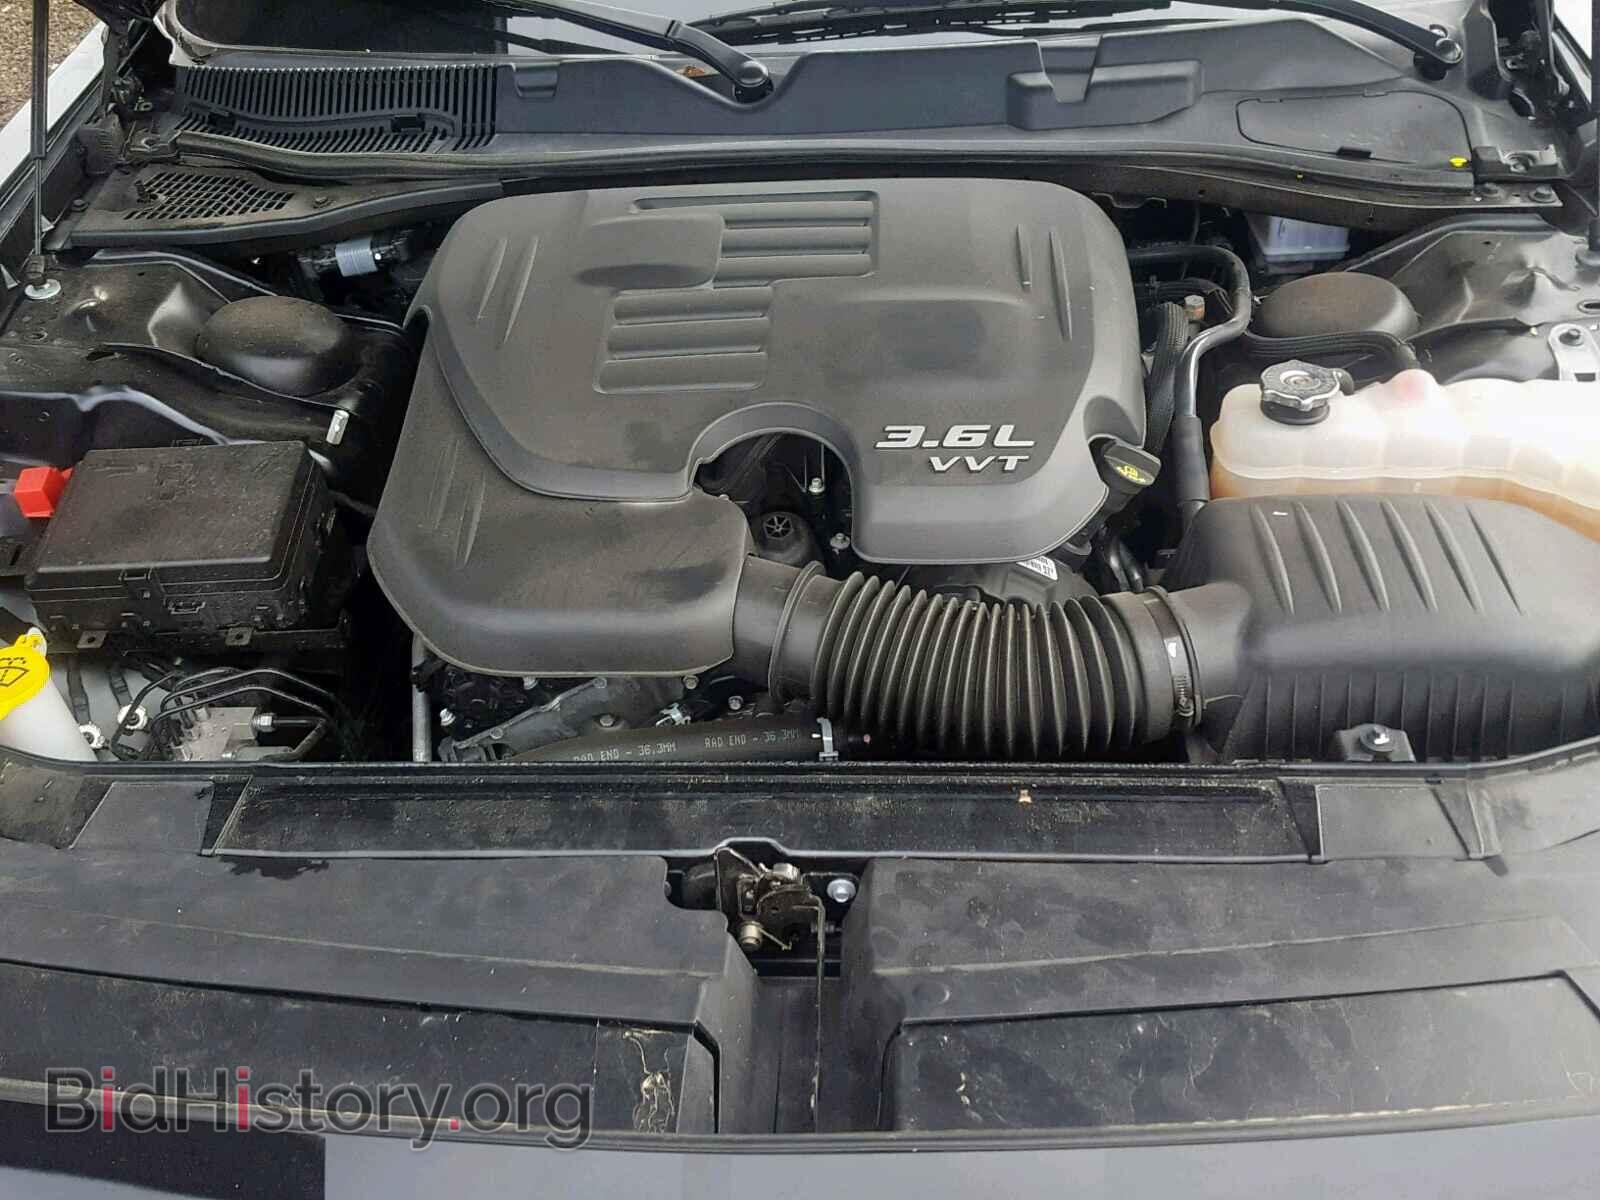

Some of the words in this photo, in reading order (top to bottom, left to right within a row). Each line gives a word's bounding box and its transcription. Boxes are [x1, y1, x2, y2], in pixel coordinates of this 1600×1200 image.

[875, 424, 1035, 449] 3.6L
[929, 455, 1030, 473] VVT
[704, 735, 723, 749] RAD
[728, 733, 747, 746] END
[600, 748, 620, 760] END
